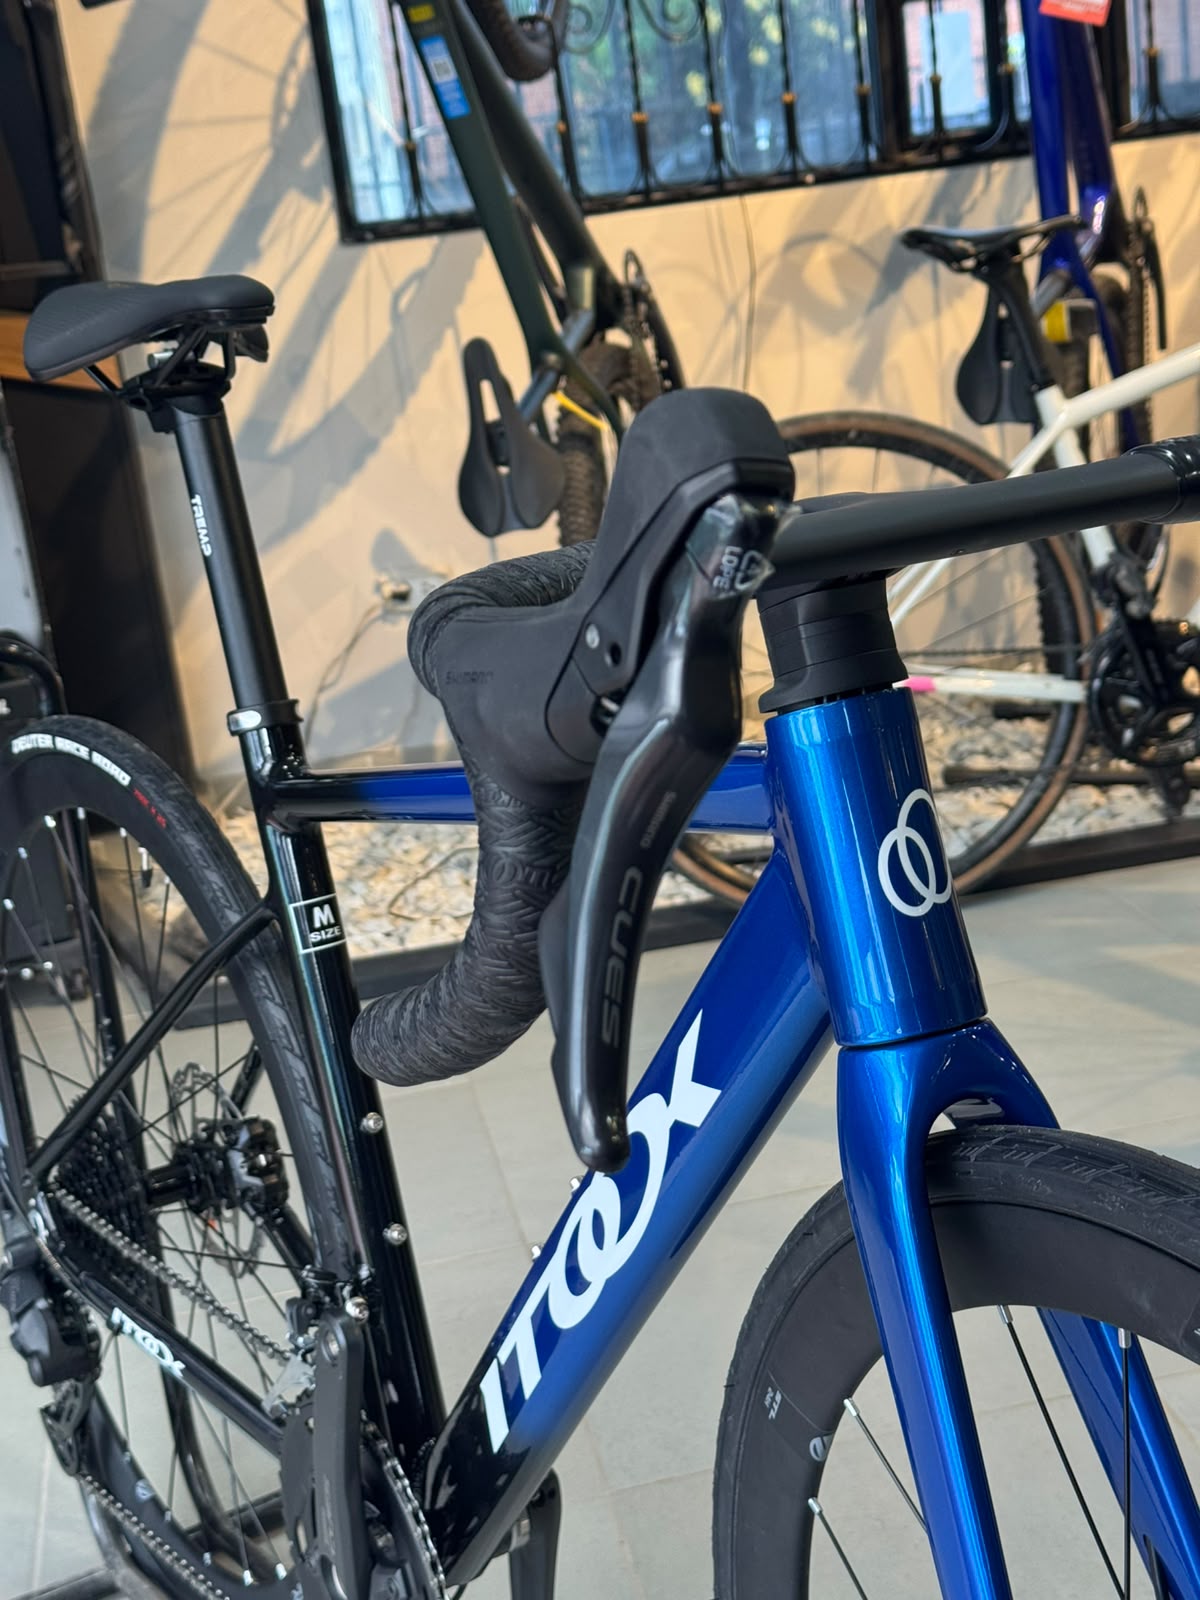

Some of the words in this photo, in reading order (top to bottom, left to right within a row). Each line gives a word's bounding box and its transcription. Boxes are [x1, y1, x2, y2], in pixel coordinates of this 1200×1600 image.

[191, 494, 212, 556] TREMP
[309, 925, 342, 942] SIZE
[313, 903, 335, 929] M
[602, 866, 643, 1049] CUES
